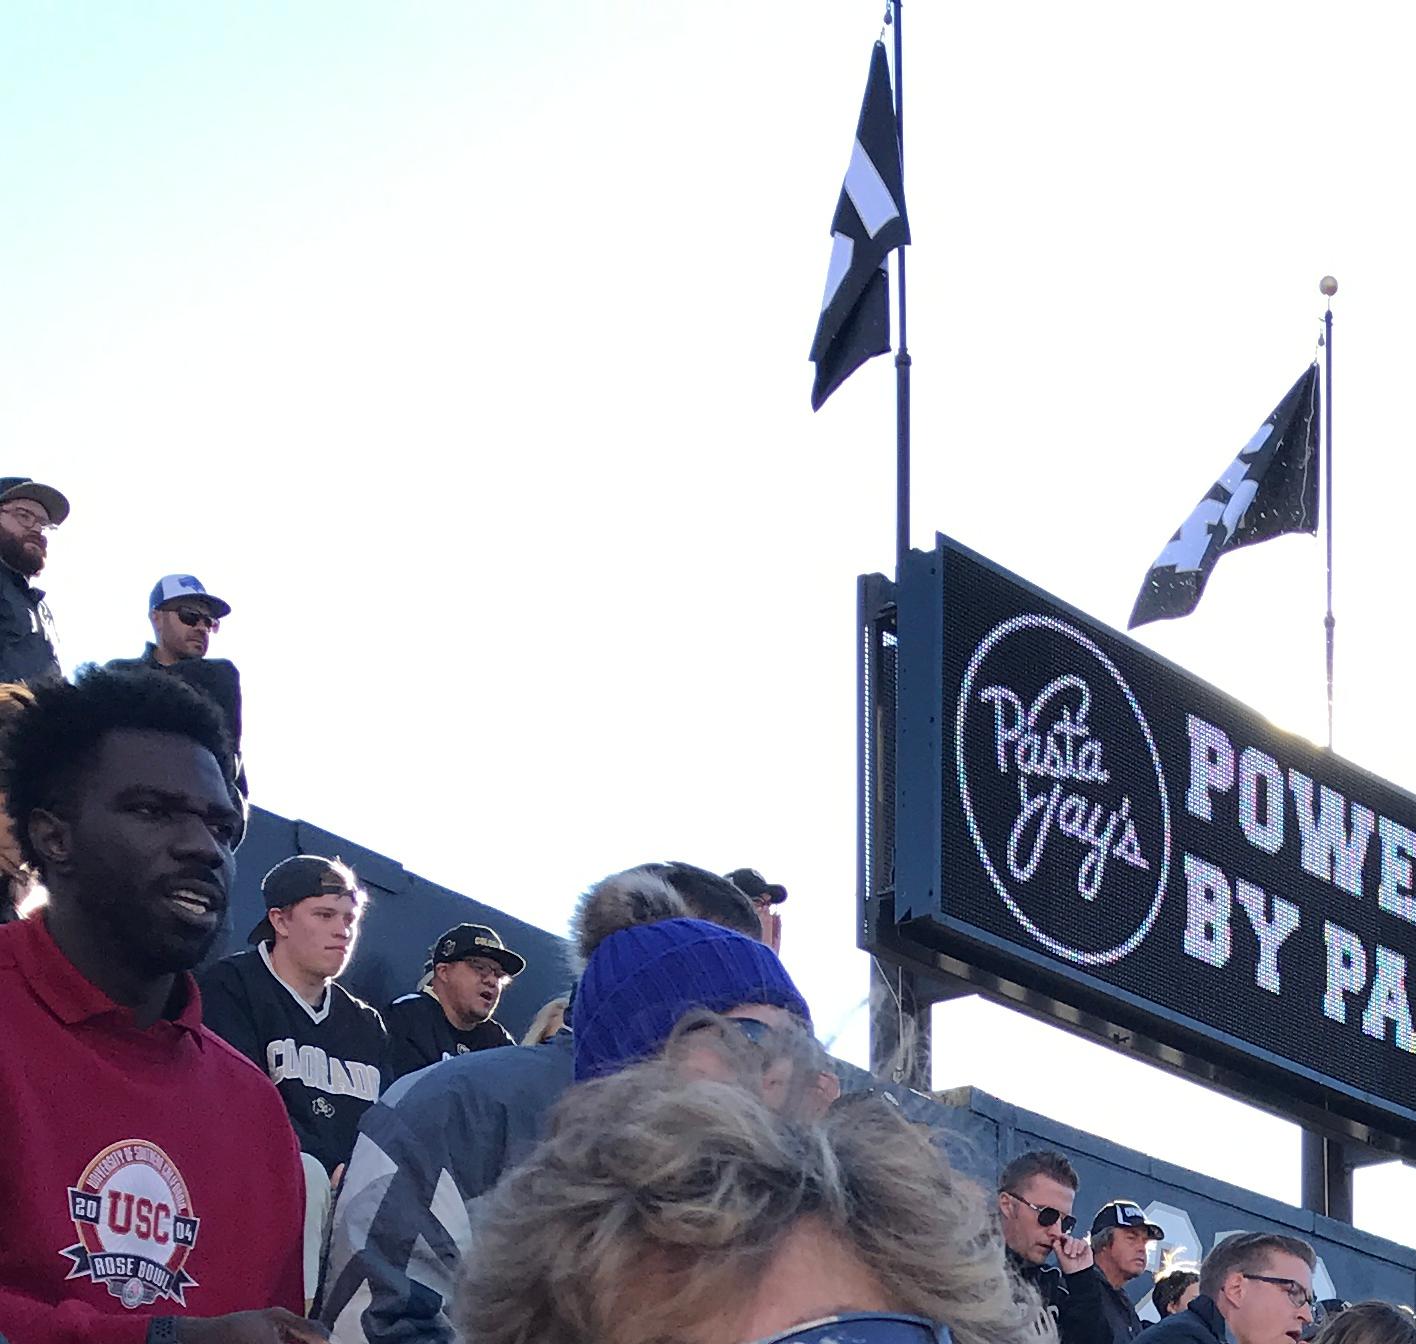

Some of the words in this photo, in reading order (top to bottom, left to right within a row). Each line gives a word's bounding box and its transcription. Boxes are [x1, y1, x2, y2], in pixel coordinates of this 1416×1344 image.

[980, 673, 1110, 783] Pasta
[1007, 775, 1150, 901] Jay's
[1183, 852, 1301, 995] BY
[266, 1037, 381, 1104] COORADO
[74, 1197, 98, 1219] 20
[107, 1189, 171, 1246] USC
[175, 1221, 193, 1242] 04
[94, 1256, 136, 1277] ROSE
[137, 1260, 171, 1291] BOWL
